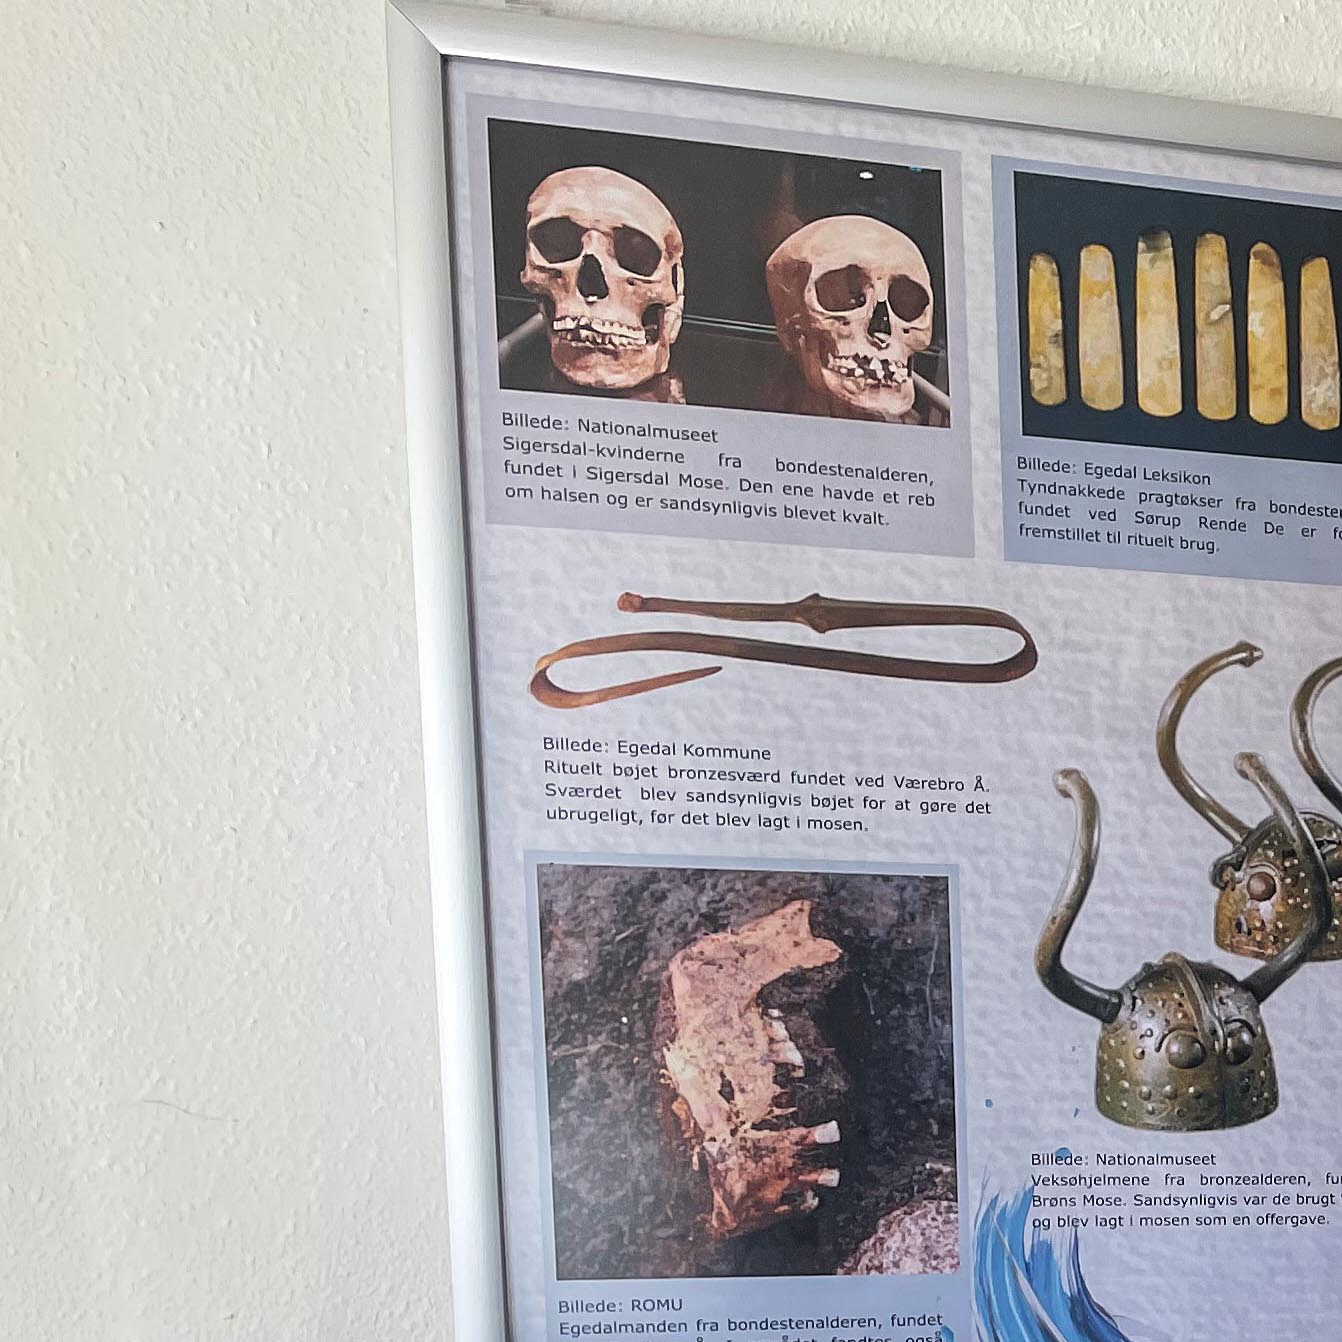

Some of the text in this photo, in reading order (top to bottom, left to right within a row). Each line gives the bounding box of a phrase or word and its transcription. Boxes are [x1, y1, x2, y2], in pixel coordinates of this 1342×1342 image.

[502, 411, 719, 443] Billede: Nationalmuseet
[502, 435, 934, 487] Sigersdal-kvinderne fra bondestenalderen,
[1017, 455, 1211, 486] Billede: Egedal Leksikon
[504, 459, 935, 507] fundet i Sigersdal Mose. Den ene havde et reb
[1016, 478, 1126, 500] Tyndnakkede
[1138, 491, 1224, 508] pragtøkser
[1235, 496, 1256, 511] fra
[505, 485, 890, 526] om halsen og er sandsynligvis blevet kvalt.
[1018, 500, 1071, 518] fundet
[1088, 507, 1117, 522] ved
[1134, 510, 1181, 530] Sørup
[1198, 515, 1247, 532] Rende
[1263, 521, 1284, 536] De
[1300, 527, 1317, 538] er
[1019, 523, 1220, 555] fremstillet til rituelt brug.
[543, 736, 771, 761] Billede: Egedal Kommune
[544, 759, 990, 793] Rituelt bøjet bronzesværd fundet ved Værebro Å.
[544, 782, 992, 815] Sværdet blev sandsynligvis bøjet for at gøre det
[546, 805, 868, 832] ubrugeligt, før det blev lagt i mosen.
[1031, 1152, 1216, 1166] Billede: Nationalmuseet
[1031, 1173, 1150, 1188] Veksøhjelmene
[1164, 1172, 1185, 1186] fra
[1199, 1172, 1311, 1187] bronzealderen,
[1031, 1194, 1077, 1207] Brøns
[1082, 1194, 1127, 1207] Mose.
[1133, 1192, 1238, 1209] Sandsynligvis
[1242, 1195, 1268, 1206] var
[1272, 1192, 1290, 1206] de
[1296, 1192, 1336, 1208] brugt
[1032, 1212, 1330, 1230] og blev lagt i mosen som en offergave.
[558, 1298, 682, 1314] Billede: ROMU
[559, 1313, 943, 1338] Egedalmanden fra bondestenalderen, fundet
